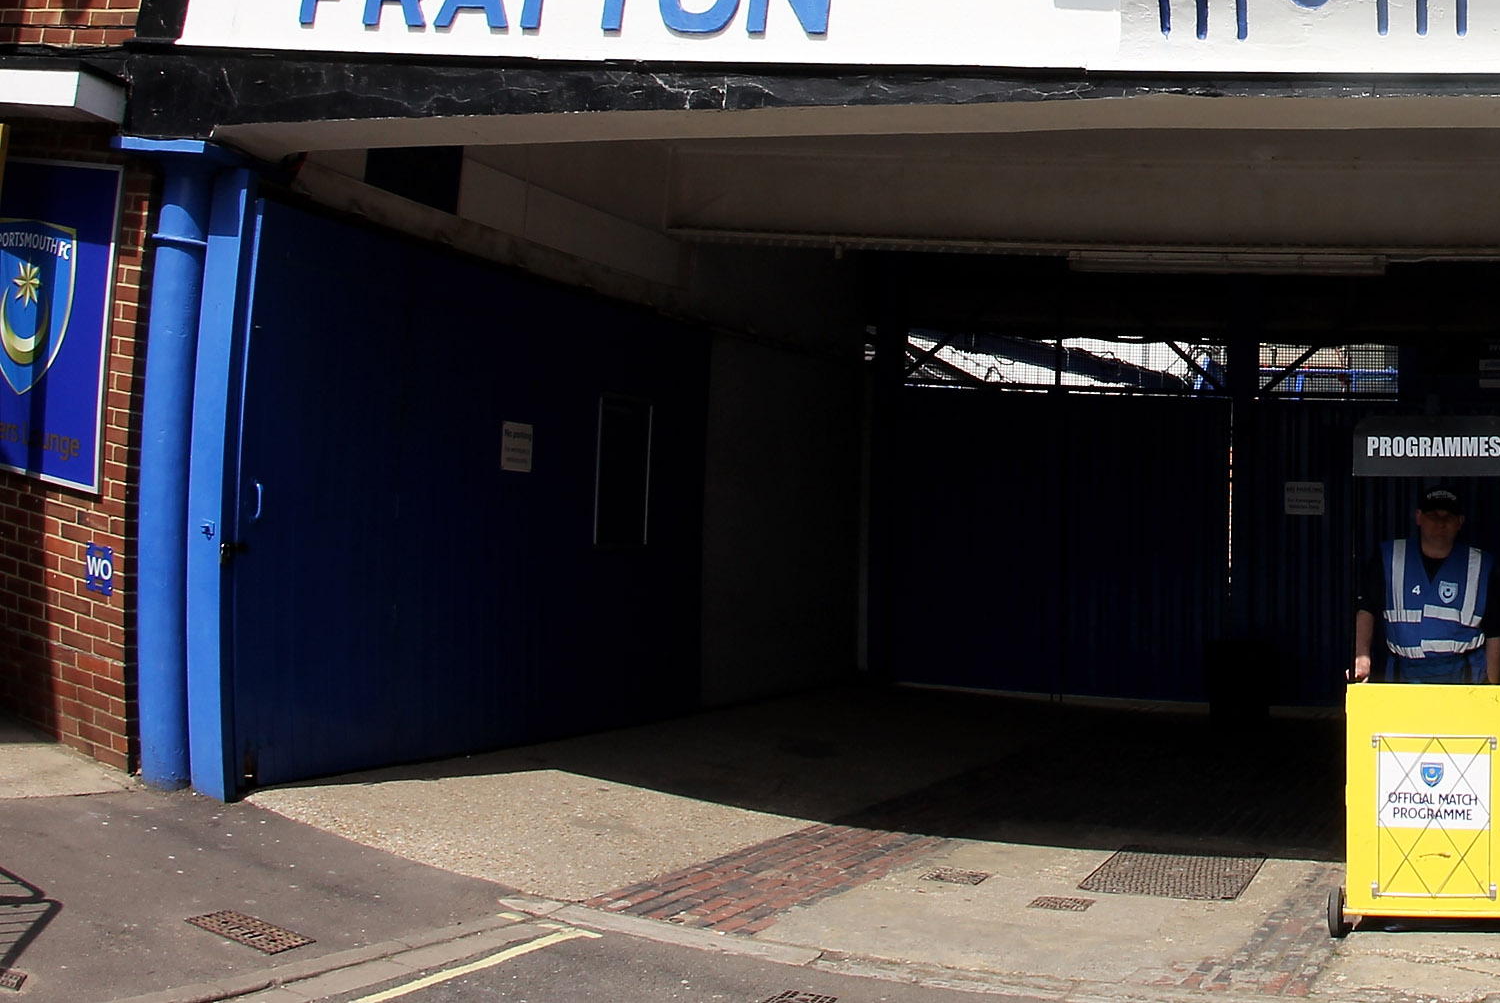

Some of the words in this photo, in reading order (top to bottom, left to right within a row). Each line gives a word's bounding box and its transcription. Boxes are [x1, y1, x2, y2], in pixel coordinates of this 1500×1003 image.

[58, 240, 72, 260] FC
[22, 419, 81, 461] Lounge
[86, 554, 113, 581] WO
[1411, 584, 1421, 596] 4
[1388, 791, 1436, 806] OFFICIAL
[1438, 792, 1478, 807] MATCH
[1392, 806, 1473, 821] PROGRAMME
